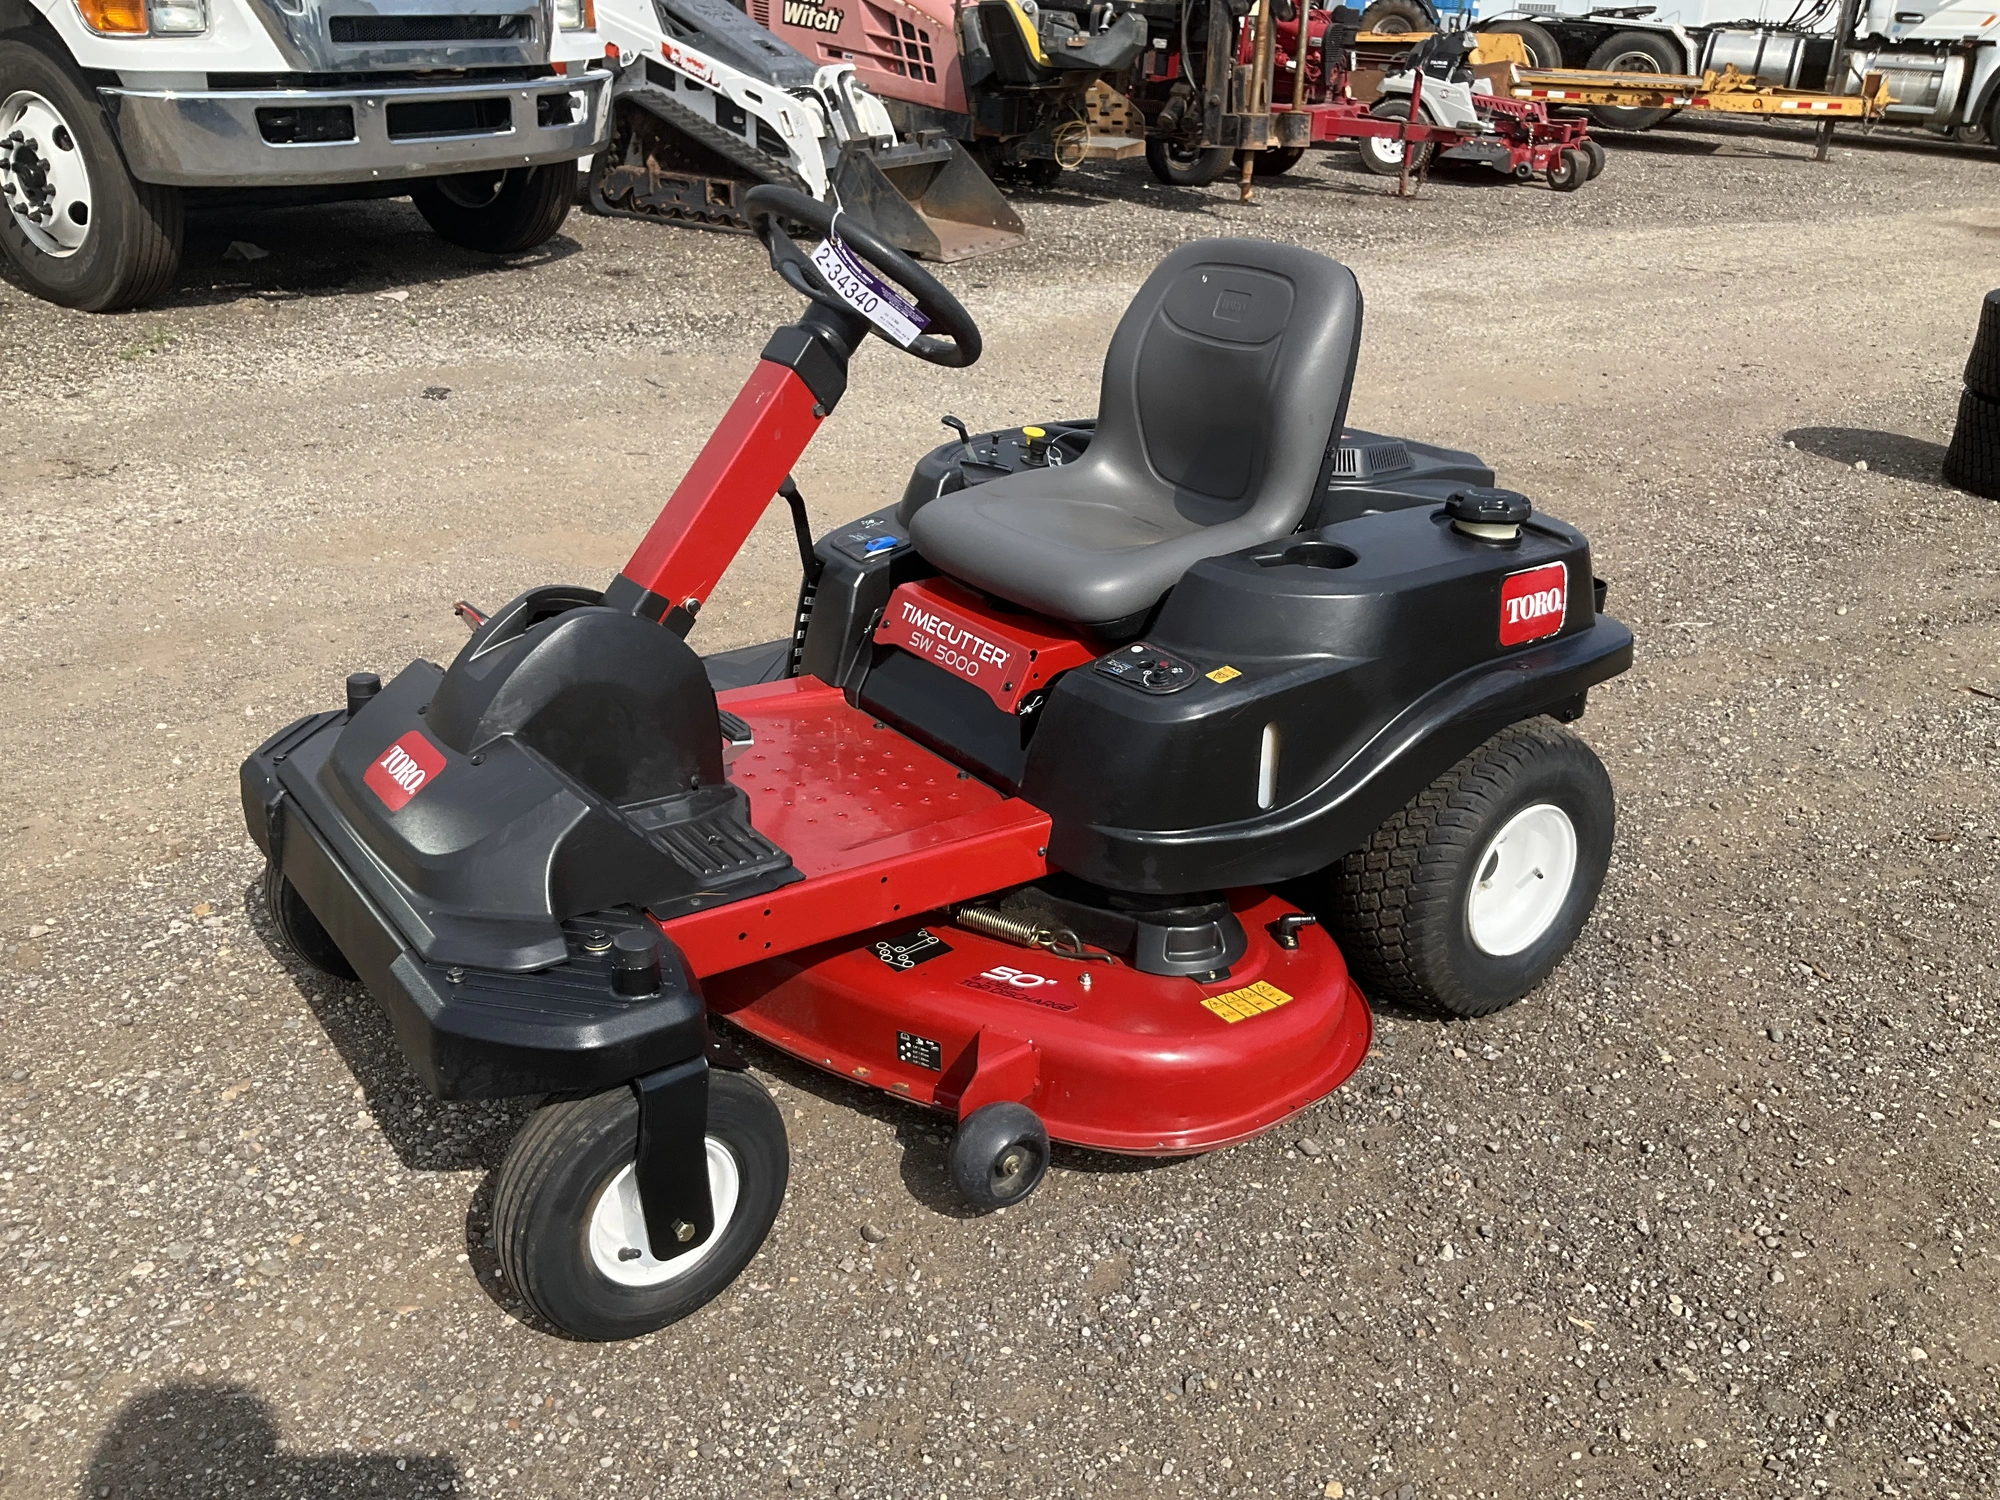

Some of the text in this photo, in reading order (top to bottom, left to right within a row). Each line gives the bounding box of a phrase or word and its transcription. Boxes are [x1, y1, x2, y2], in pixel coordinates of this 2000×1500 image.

[784, 1, 840, 32] Witch
[815, 247, 879, 313] 2-34340
[1506, 587, 1561, 624] TORO
[901, 601, 1008, 669] TIMECUTTER
[908, 631, 979, 677] SW 5000
[381, 744, 426, 791] TORO
[958, 980, 1076, 1012] TOP DISCHARGE
[980, 965, 1059, 988] 50"
